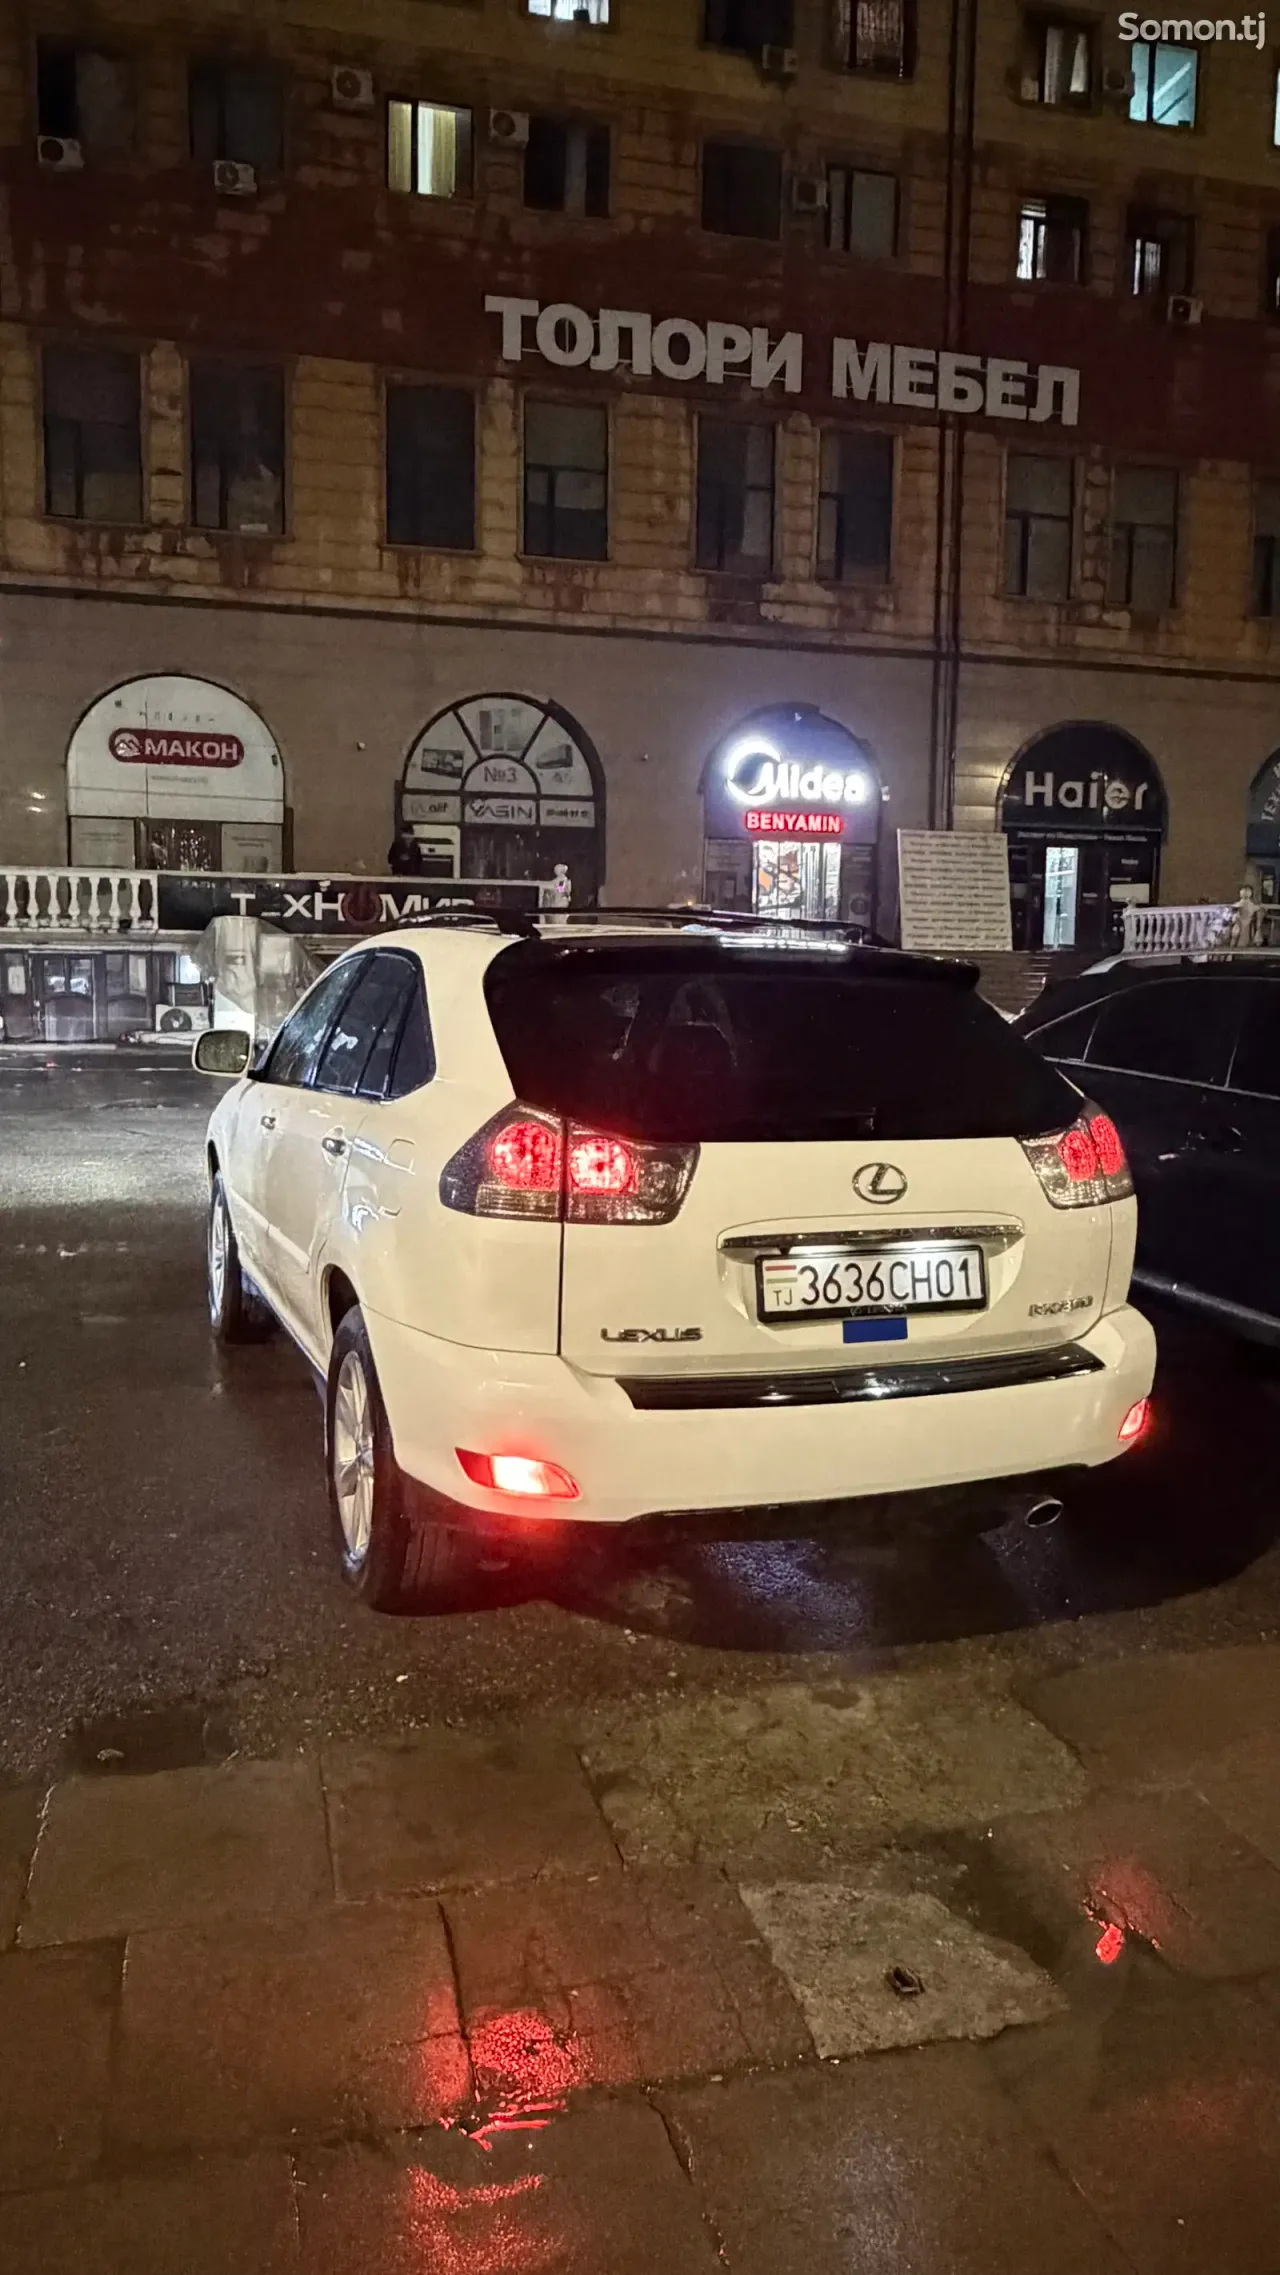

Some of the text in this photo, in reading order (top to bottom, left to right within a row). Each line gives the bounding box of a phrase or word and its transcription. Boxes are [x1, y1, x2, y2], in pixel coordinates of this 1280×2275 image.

[485, 295, 1081, 426] ТОЛОРИ МЕБЕЛ
[145, 738, 238, 760] МАКОН
[731, 749, 867, 804] Midea
[1025, 771, 1149, 811] Haier
[746, 812, 842, 833] BENYAMIN
[773, 1258, 972, 1306] TJ 3636CH01
[600, 1328, 703, 1343] LEXUS
